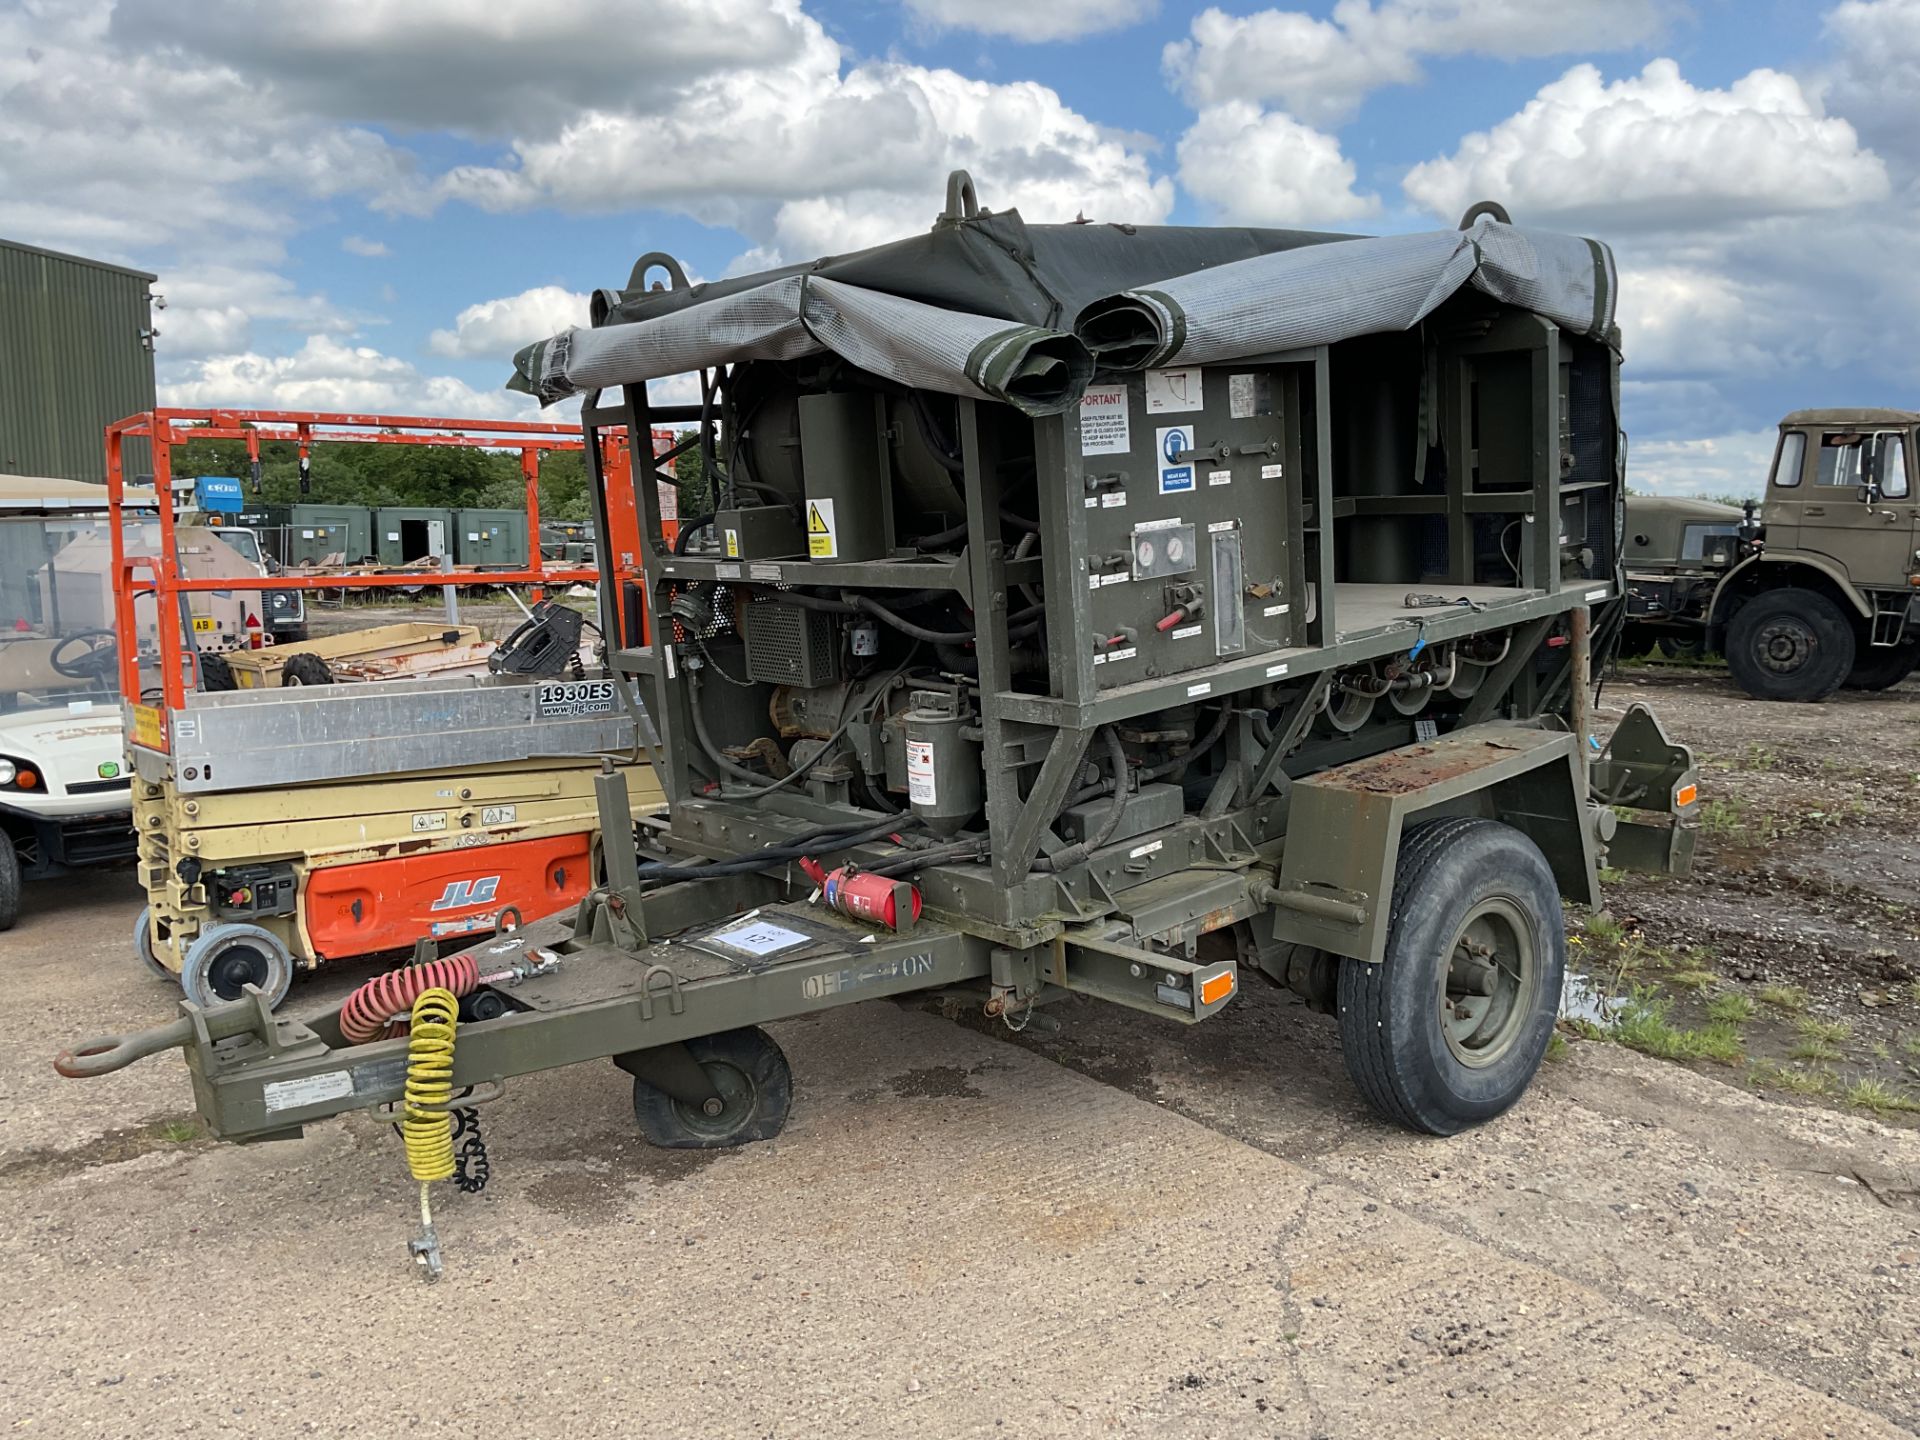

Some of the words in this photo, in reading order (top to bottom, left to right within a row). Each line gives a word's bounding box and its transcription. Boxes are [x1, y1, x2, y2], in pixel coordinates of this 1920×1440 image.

[1080, 394, 1121, 405] PORTANT
[541, 682, 614, 704] 1930ES
[543, 702, 610, 715] www.jlg.com
[430, 876, 500, 911] JLG
[902, 953, 933, 977] ON
